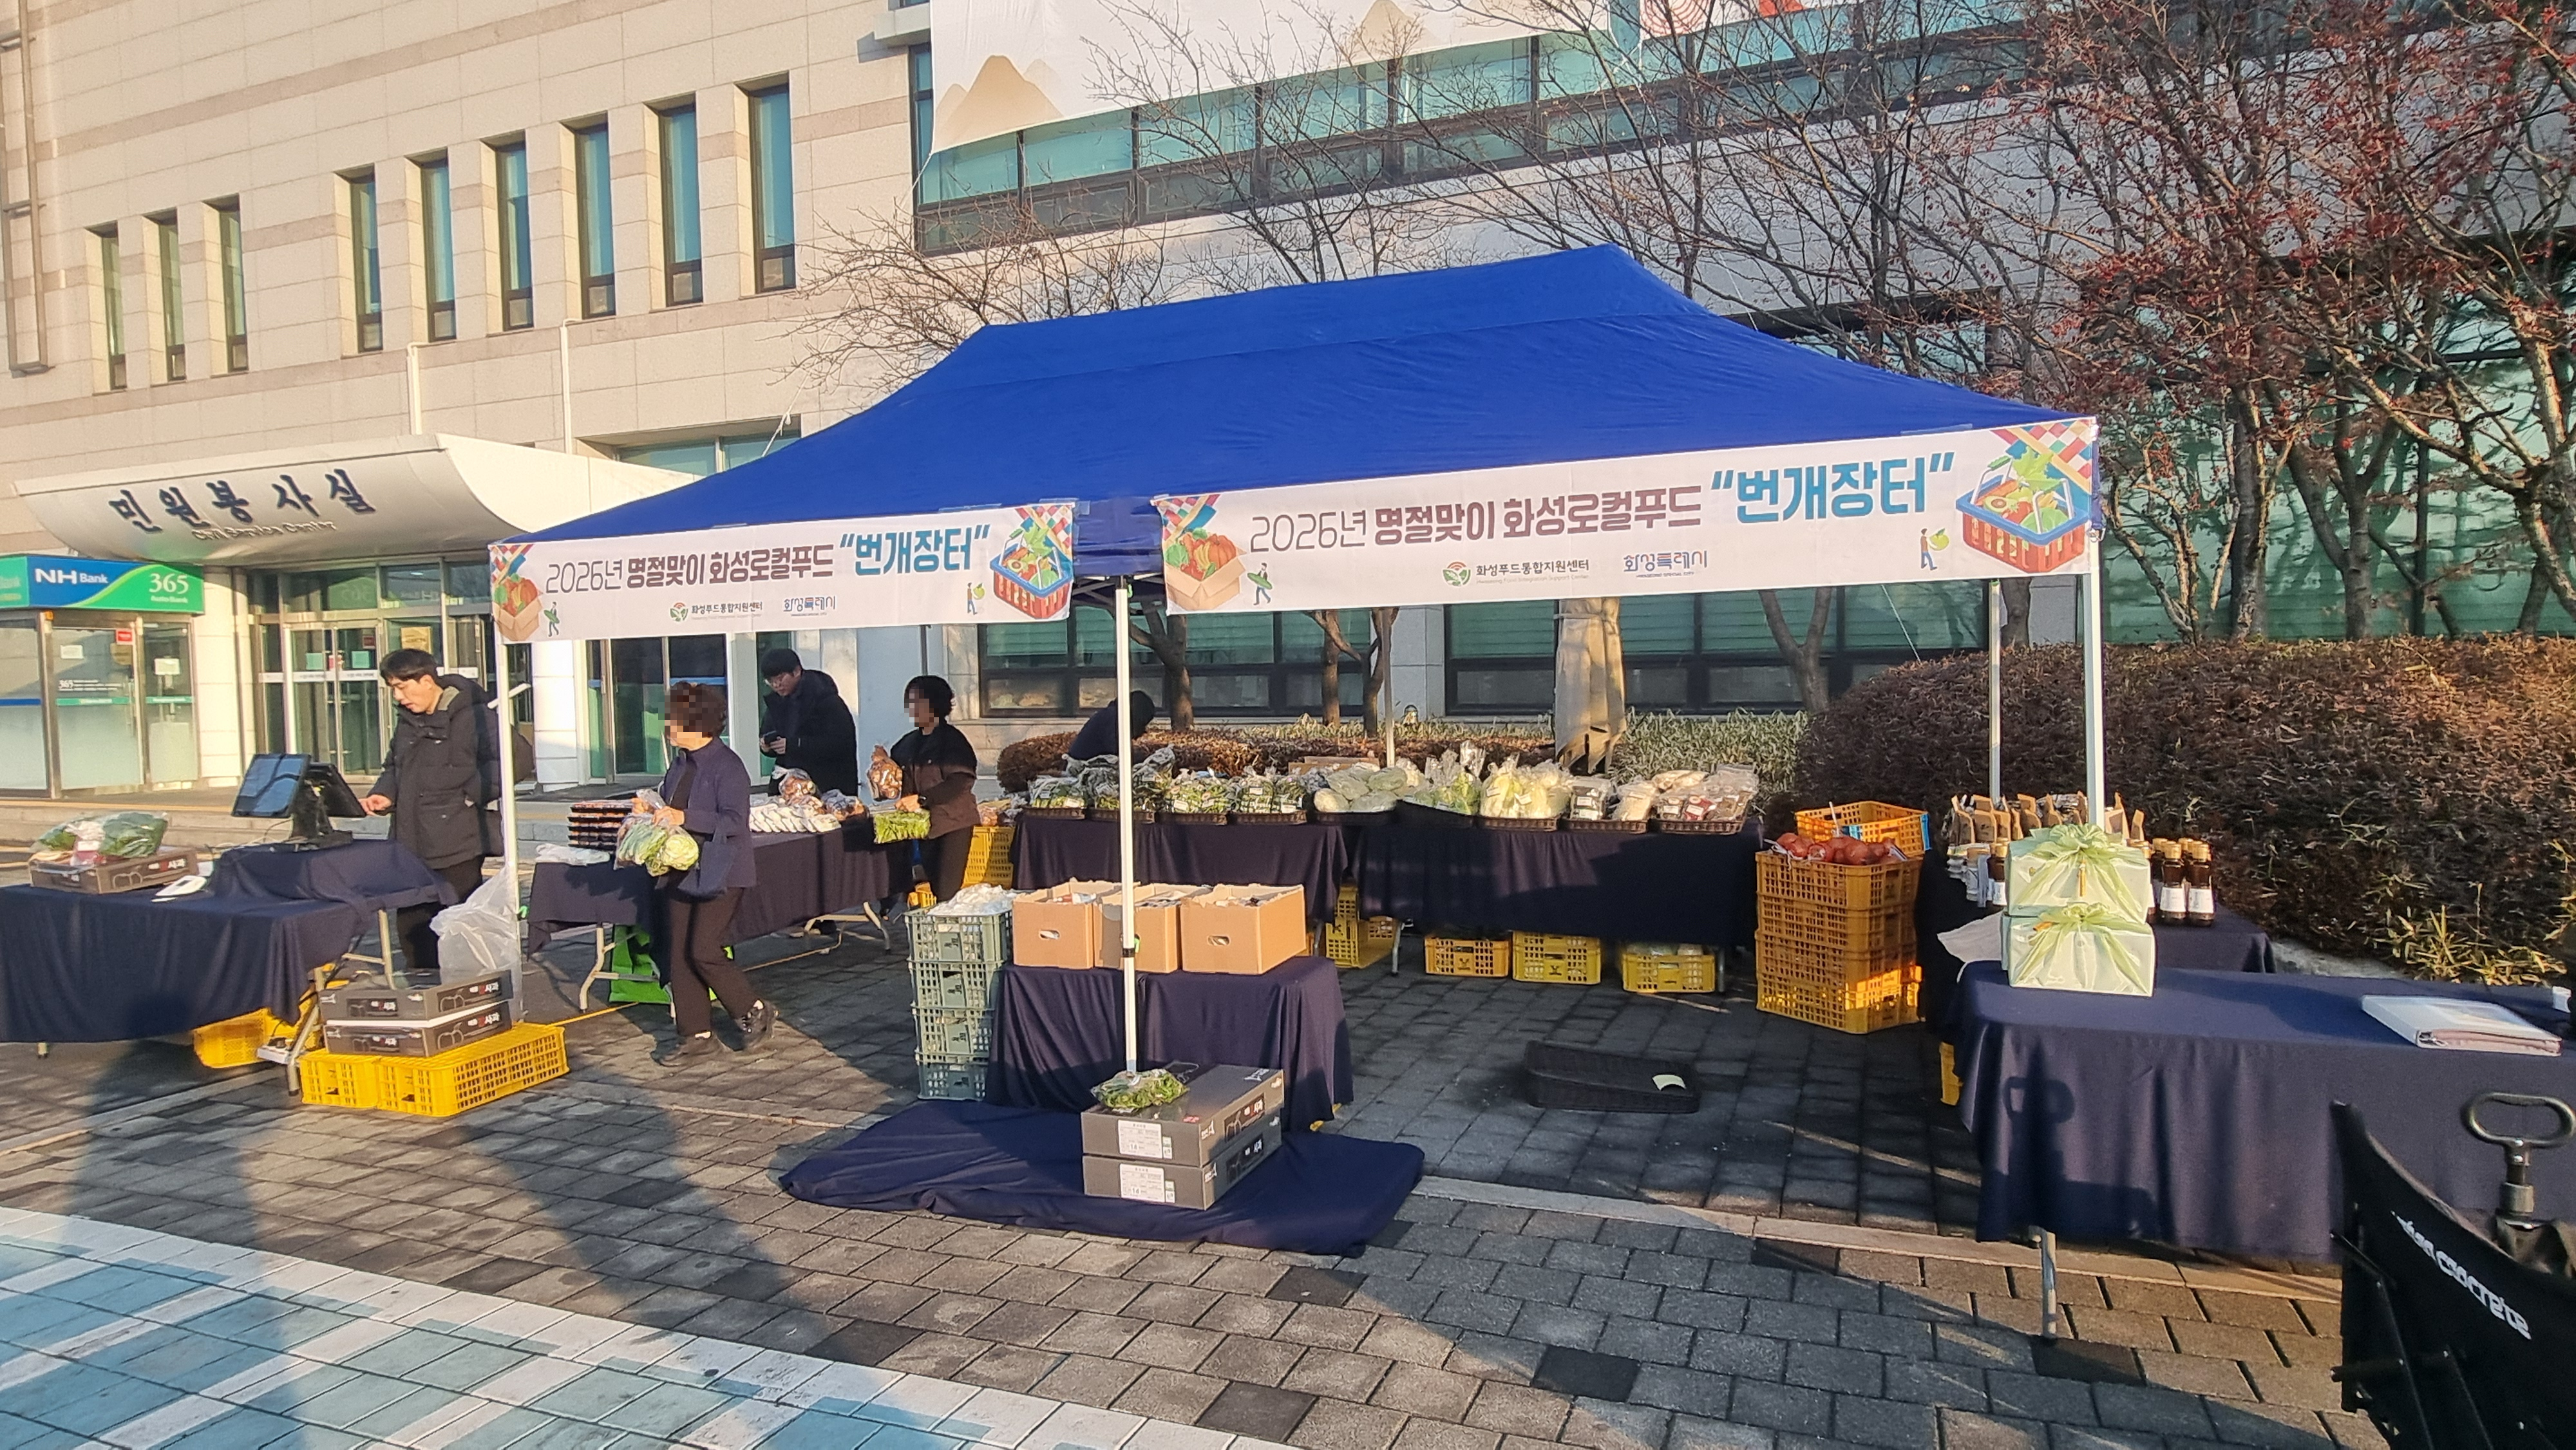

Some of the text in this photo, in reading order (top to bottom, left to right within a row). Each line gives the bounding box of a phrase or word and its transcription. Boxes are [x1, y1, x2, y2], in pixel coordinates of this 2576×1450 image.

[108, 469, 377, 533] 민원봉사실
[1250, 451, 1955, 553] 2026년 명절맞이 화성로컬푸드 “번개장터”
[545, 523, 990, 594] 2026년 명절맞이 화성로컬푸드 “번개장터”
[1475, 559, 1589, 577] 화성푸드통합지원센터
[1623, 550, 1707, 572] 화성특례시
[35, 568, 77, 585] NH
[79, 572, 109, 583] Bank
[149, 572, 189, 594] 365
[691, 601, 762, 615] 화성푸드통합지원센터
[782, 596, 835, 612] 화성특례시
